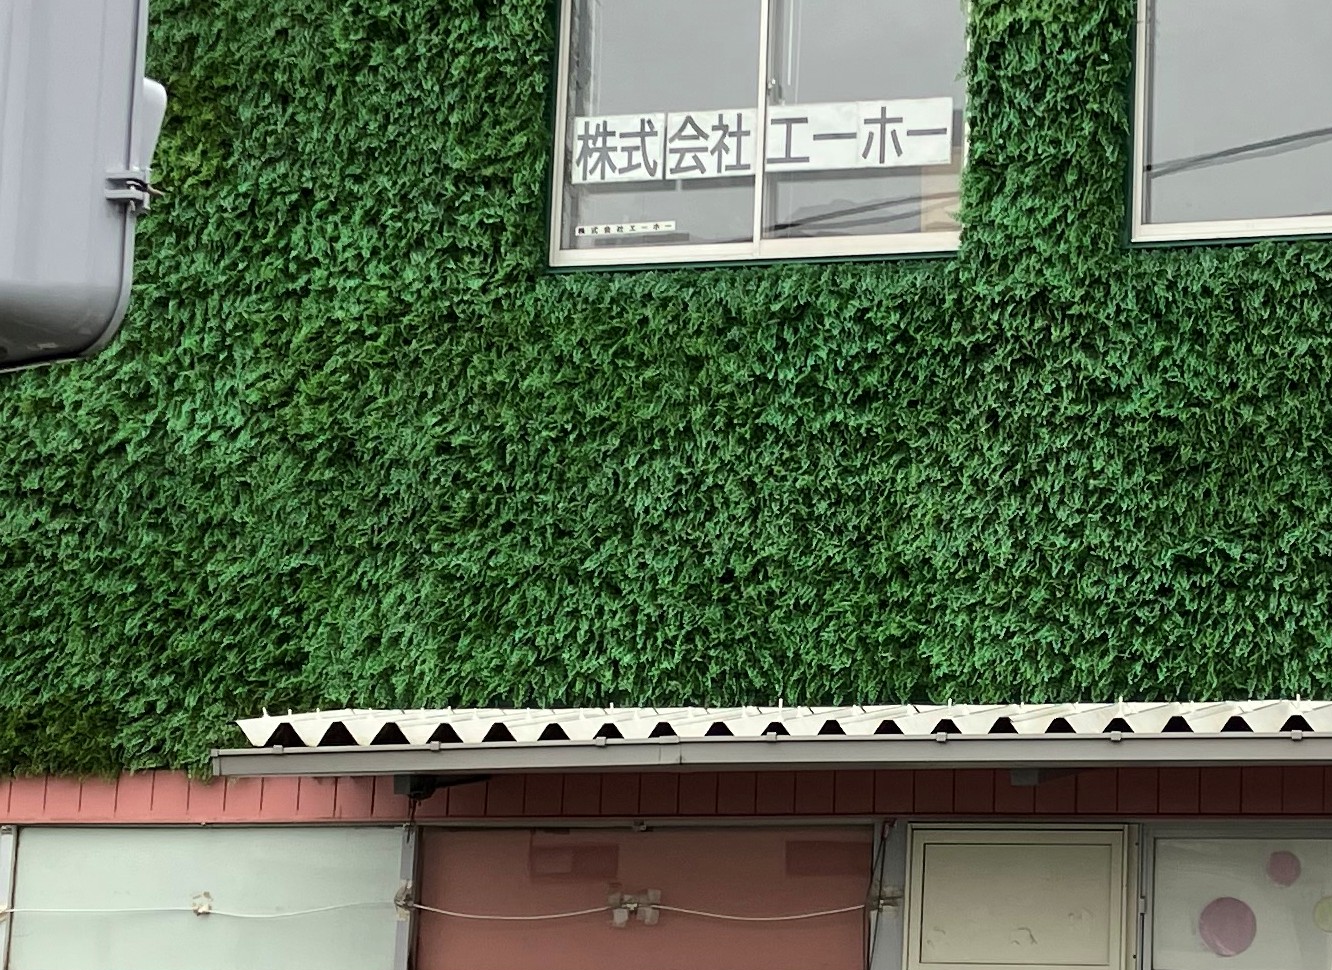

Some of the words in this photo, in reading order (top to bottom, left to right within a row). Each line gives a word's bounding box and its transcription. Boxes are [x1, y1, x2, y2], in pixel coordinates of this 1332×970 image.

[576, 106, 948, 181] 株式会社エーホー
